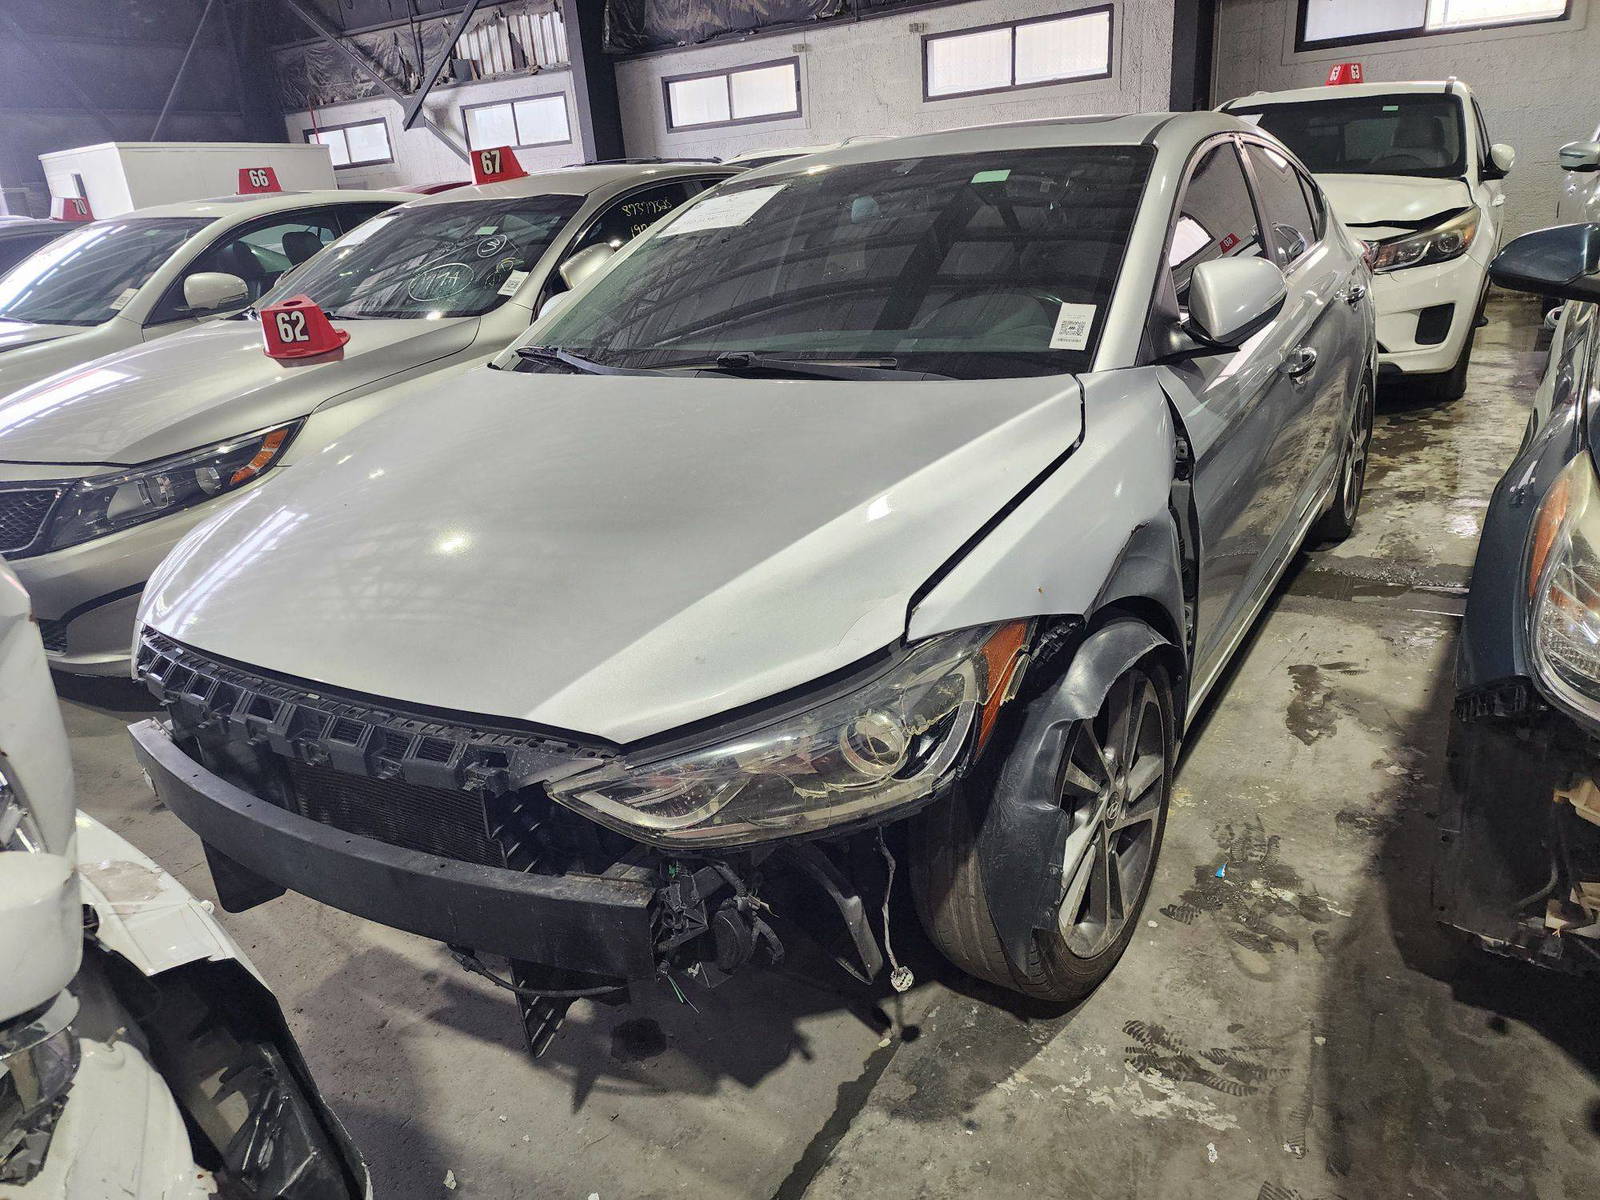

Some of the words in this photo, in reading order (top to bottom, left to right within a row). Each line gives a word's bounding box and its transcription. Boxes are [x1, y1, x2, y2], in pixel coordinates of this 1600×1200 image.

[480, 149, 501, 176] 67
[248, 168, 270, 187] 66
[275, 309, 311, 343] 62
